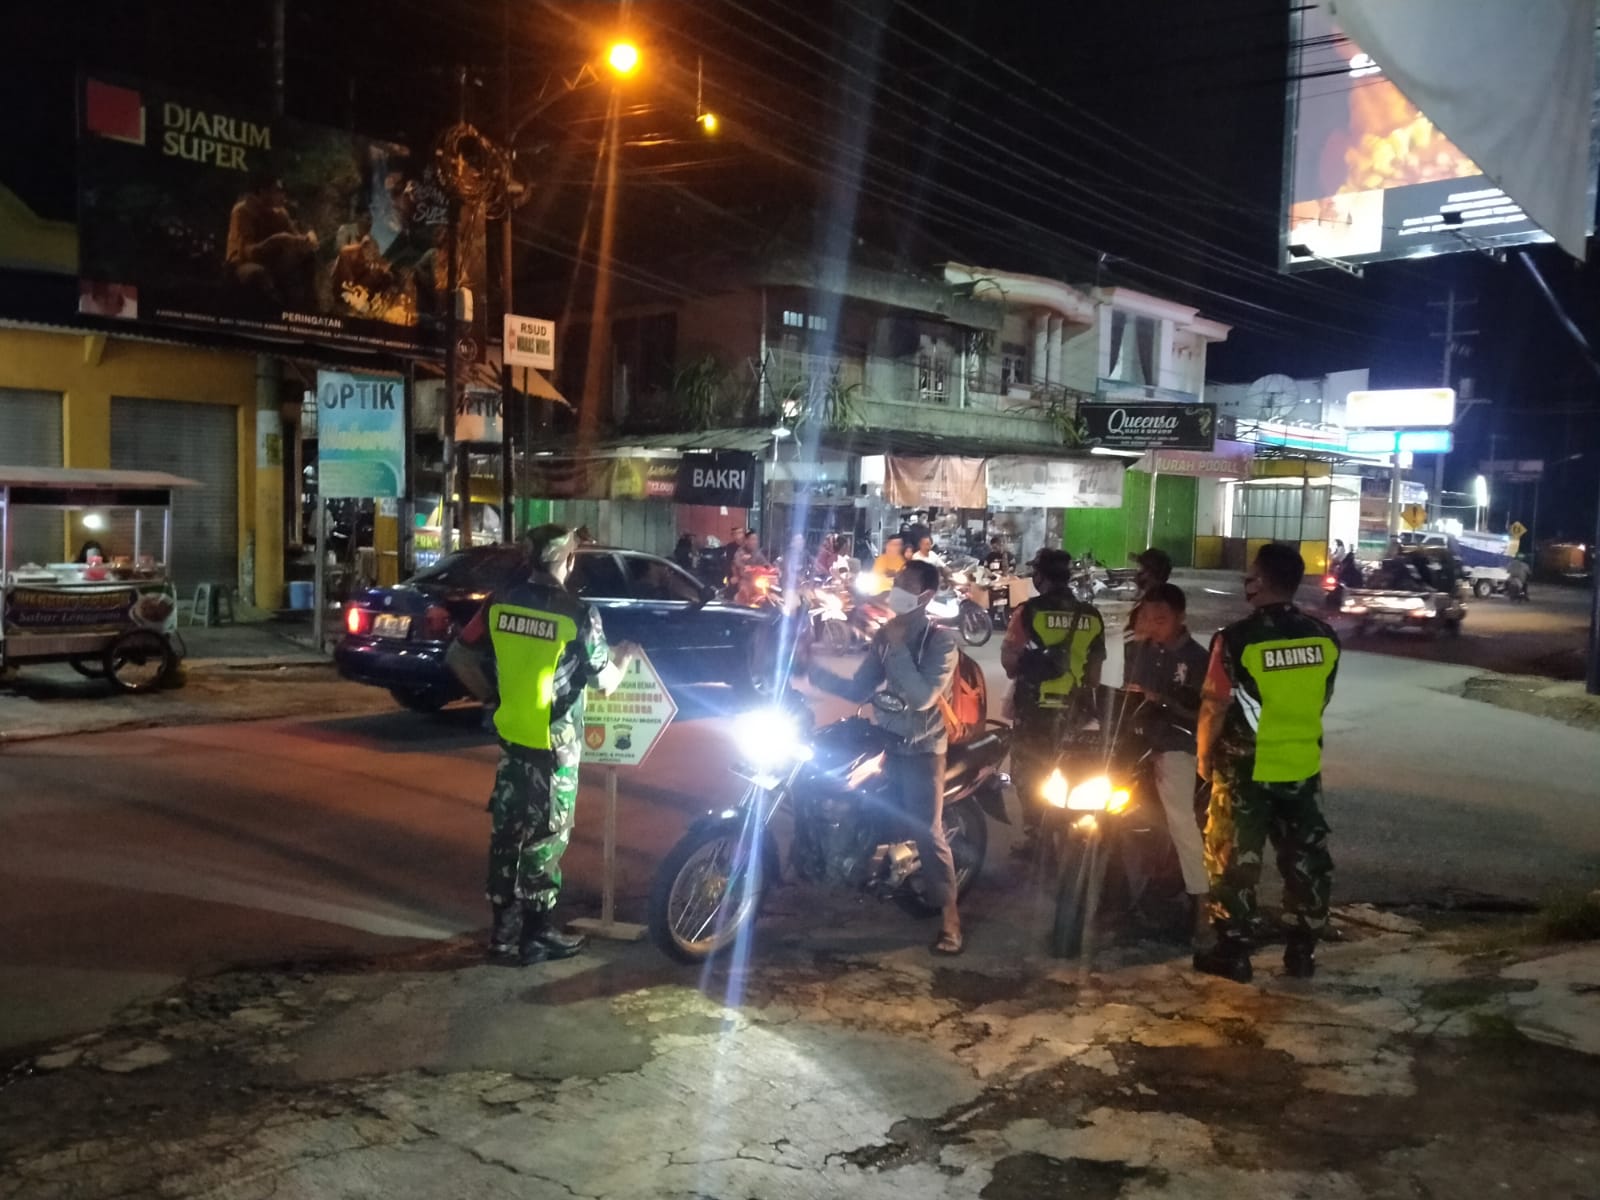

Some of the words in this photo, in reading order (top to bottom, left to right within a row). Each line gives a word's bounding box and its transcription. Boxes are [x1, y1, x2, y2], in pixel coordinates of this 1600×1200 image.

[163, 102, 272, 151] DJARUM
[162, 130, 248, 173] SUPER
[520, 322, 547, 337] RSUD
[323, 381, 396, 411] OPTIK
[1107, 408, 1180, 435] Queensa
[692, 468, 746, 490] BAKRI
[498, 614, 555, 640] BABINSA
[1047, 615, 1091, 630] BABISA
[1264, 646, 1323, 668] BABINSA
